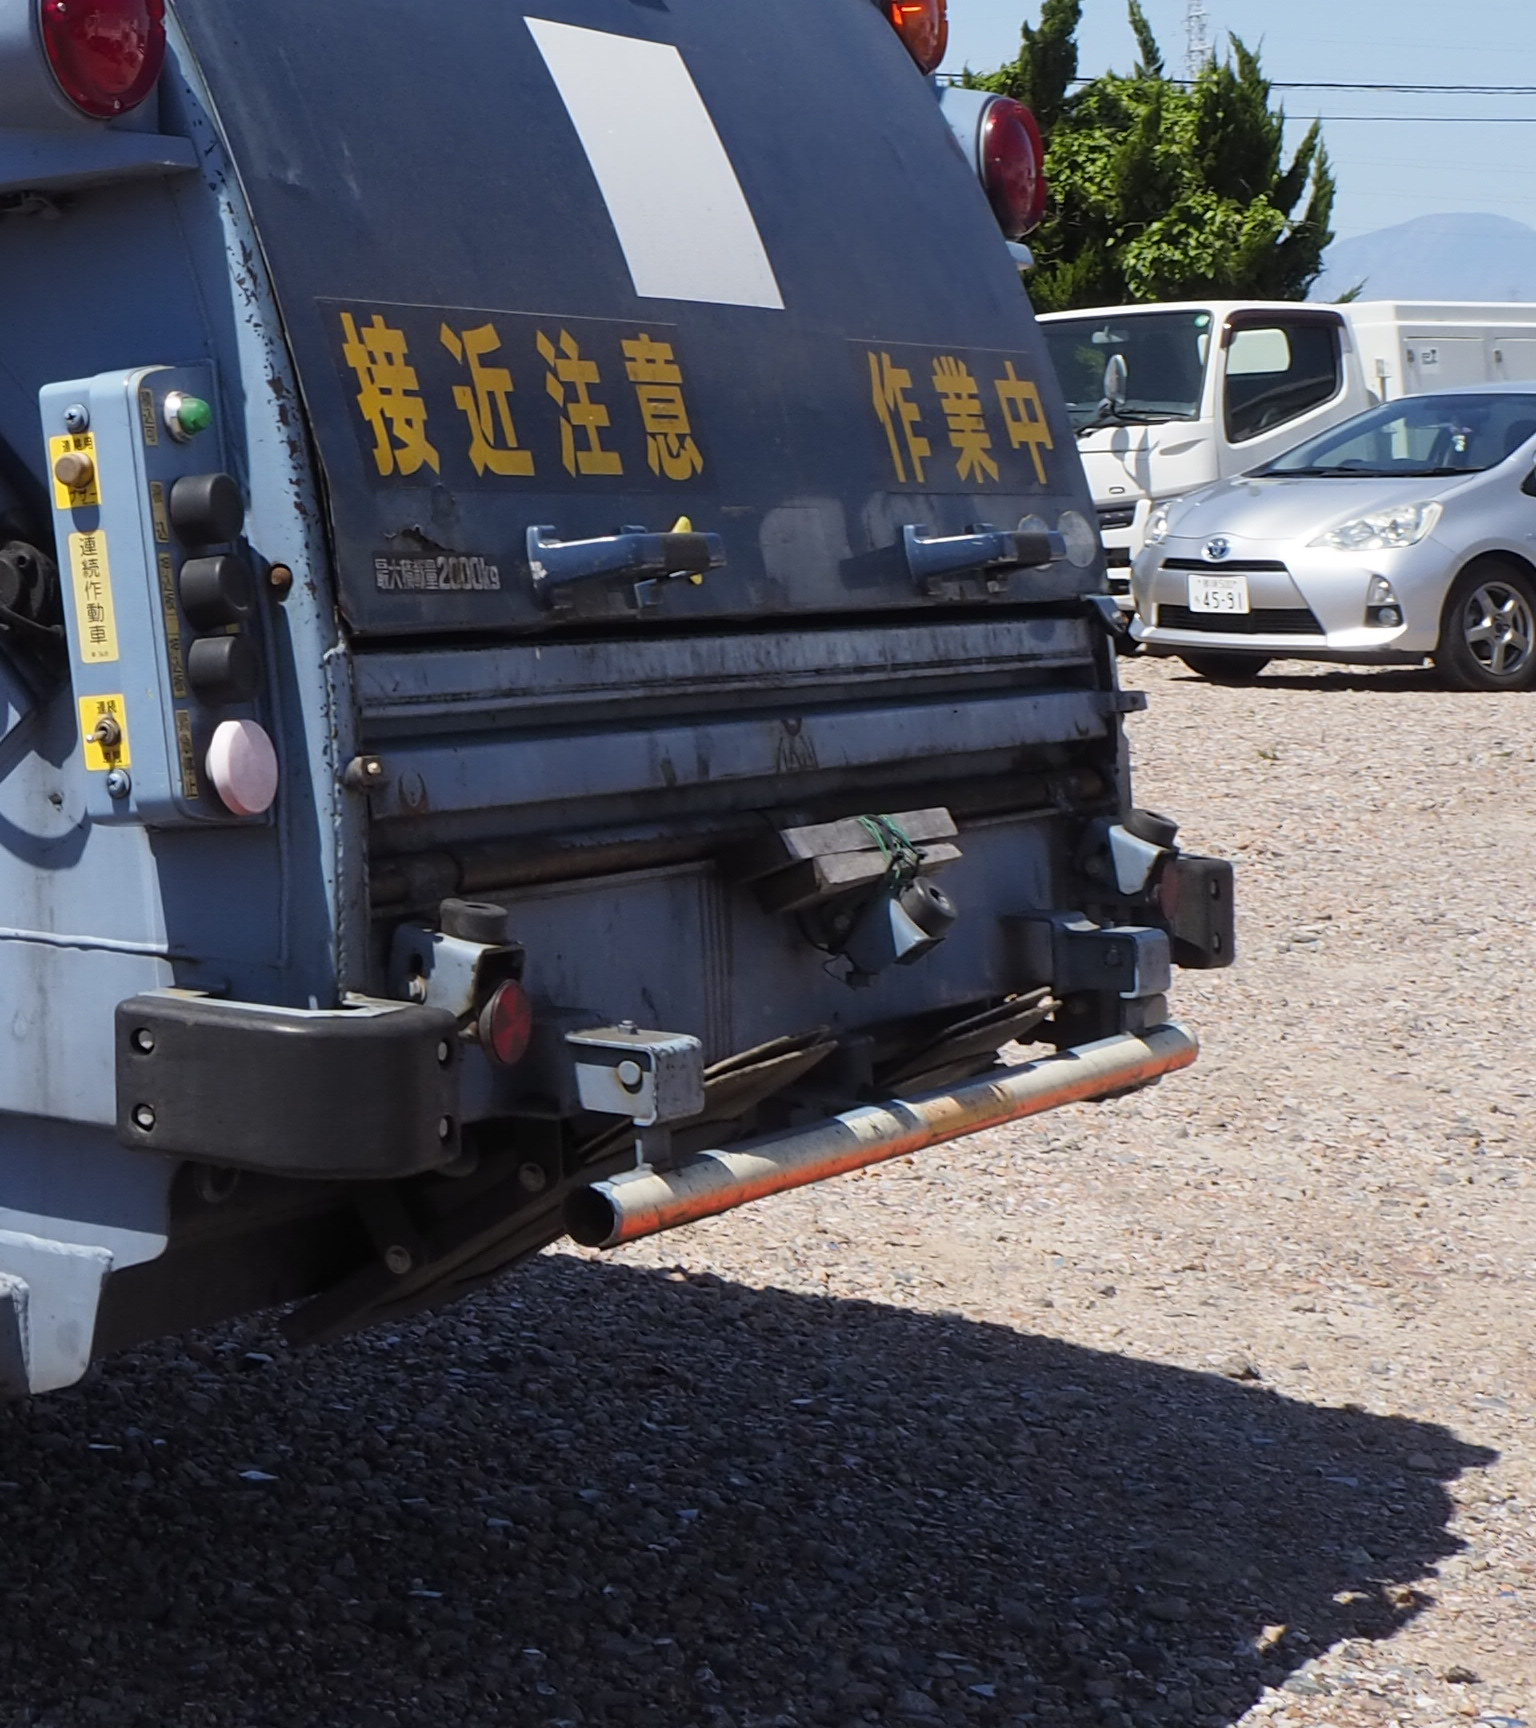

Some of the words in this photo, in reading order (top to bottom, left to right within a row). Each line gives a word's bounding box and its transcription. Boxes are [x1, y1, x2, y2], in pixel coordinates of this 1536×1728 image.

[340, 312, 704, 480] 接近注意
[868, 351, 1054, 485] 作業中
[79, 536, 108, 644] 連続作動車
